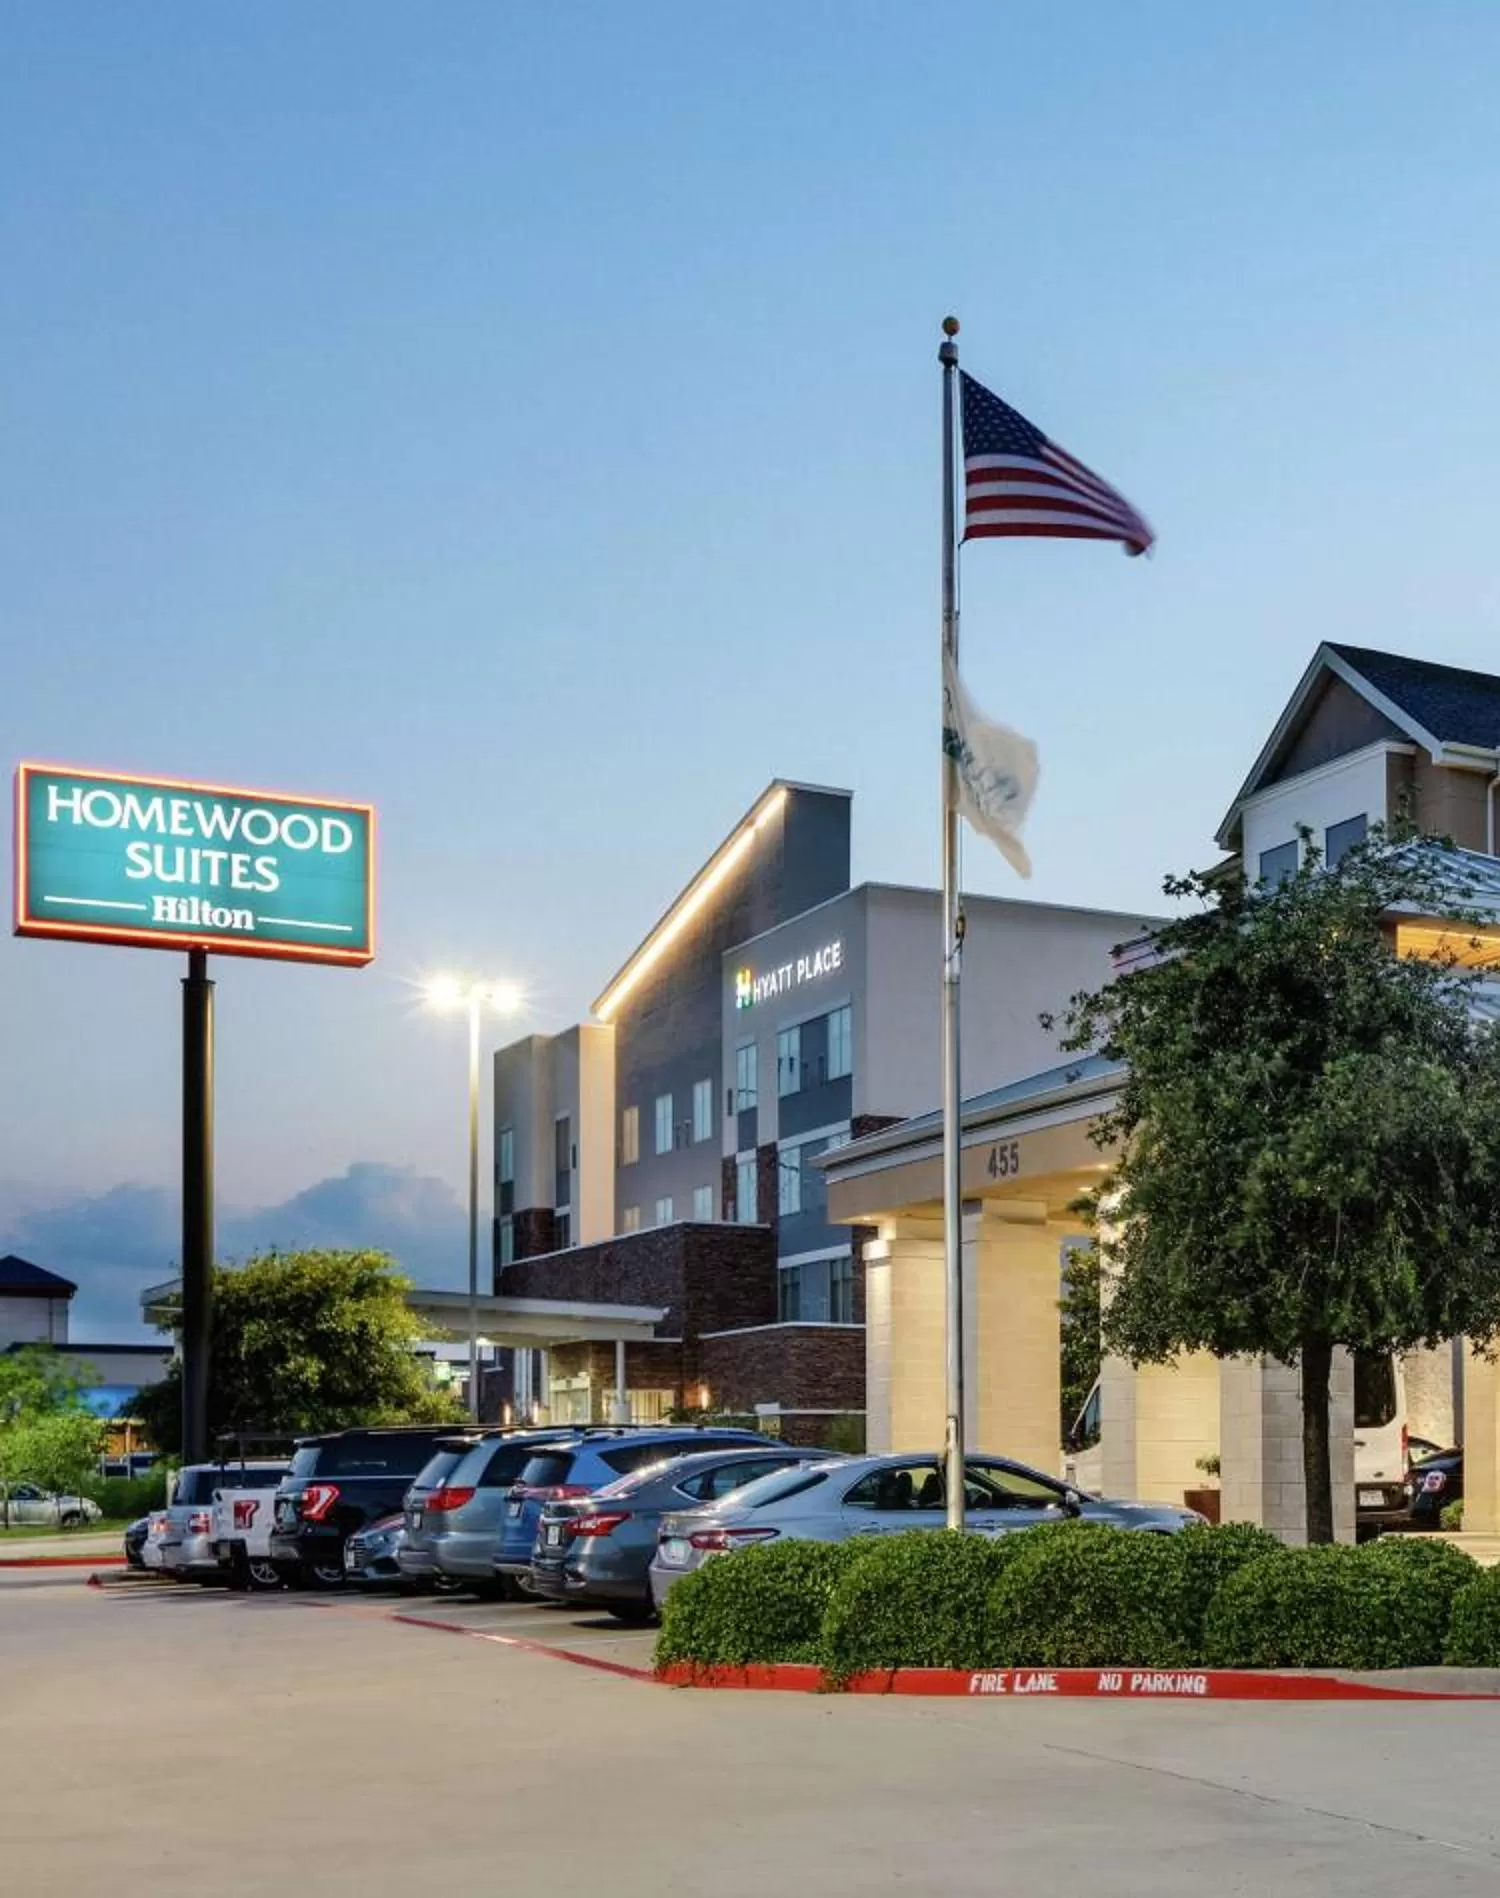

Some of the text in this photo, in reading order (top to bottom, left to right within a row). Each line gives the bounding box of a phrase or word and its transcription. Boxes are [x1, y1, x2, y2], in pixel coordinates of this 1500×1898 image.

[47, 785, 353, 853] HOMEWOOD
[125, 842, 280, 892] SUITES
[151, 895, 256, 930] Hilton
[753, 940, 841, 1004] HYATT PLACE
[988, 1141, 1019, 1179] 455
[969, 1672, 1207, 1694] FIRE LANE NO PARKING
